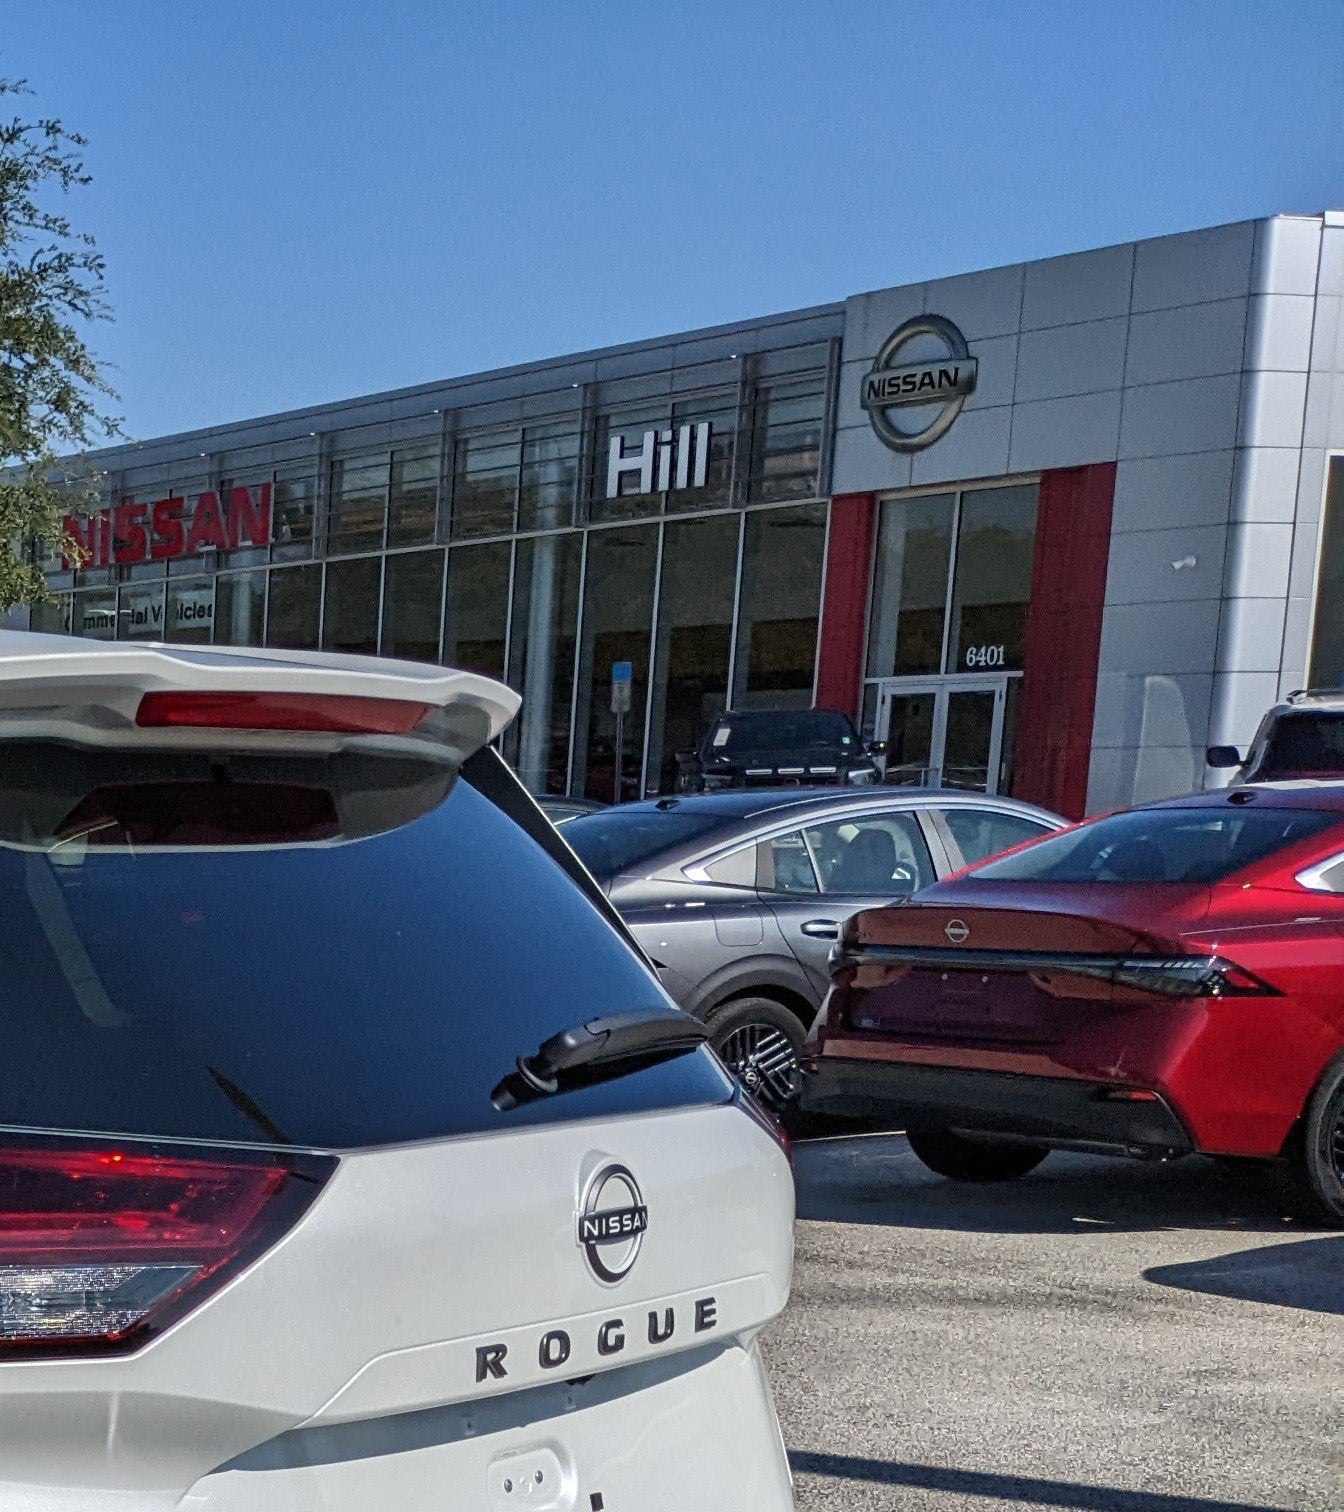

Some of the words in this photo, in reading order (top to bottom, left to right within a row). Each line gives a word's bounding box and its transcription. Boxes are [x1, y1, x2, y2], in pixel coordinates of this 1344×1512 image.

[867, 367, 960, 400] NISSAN
[606, 422, 711, 499] Hill
[62, 483, 275, 572] NISSAN
[966, 645, 1005, 667] 6401
[583, 1211, 648, 1238] NISSAN
[475, 1296, 718, 1383] ROGUE
